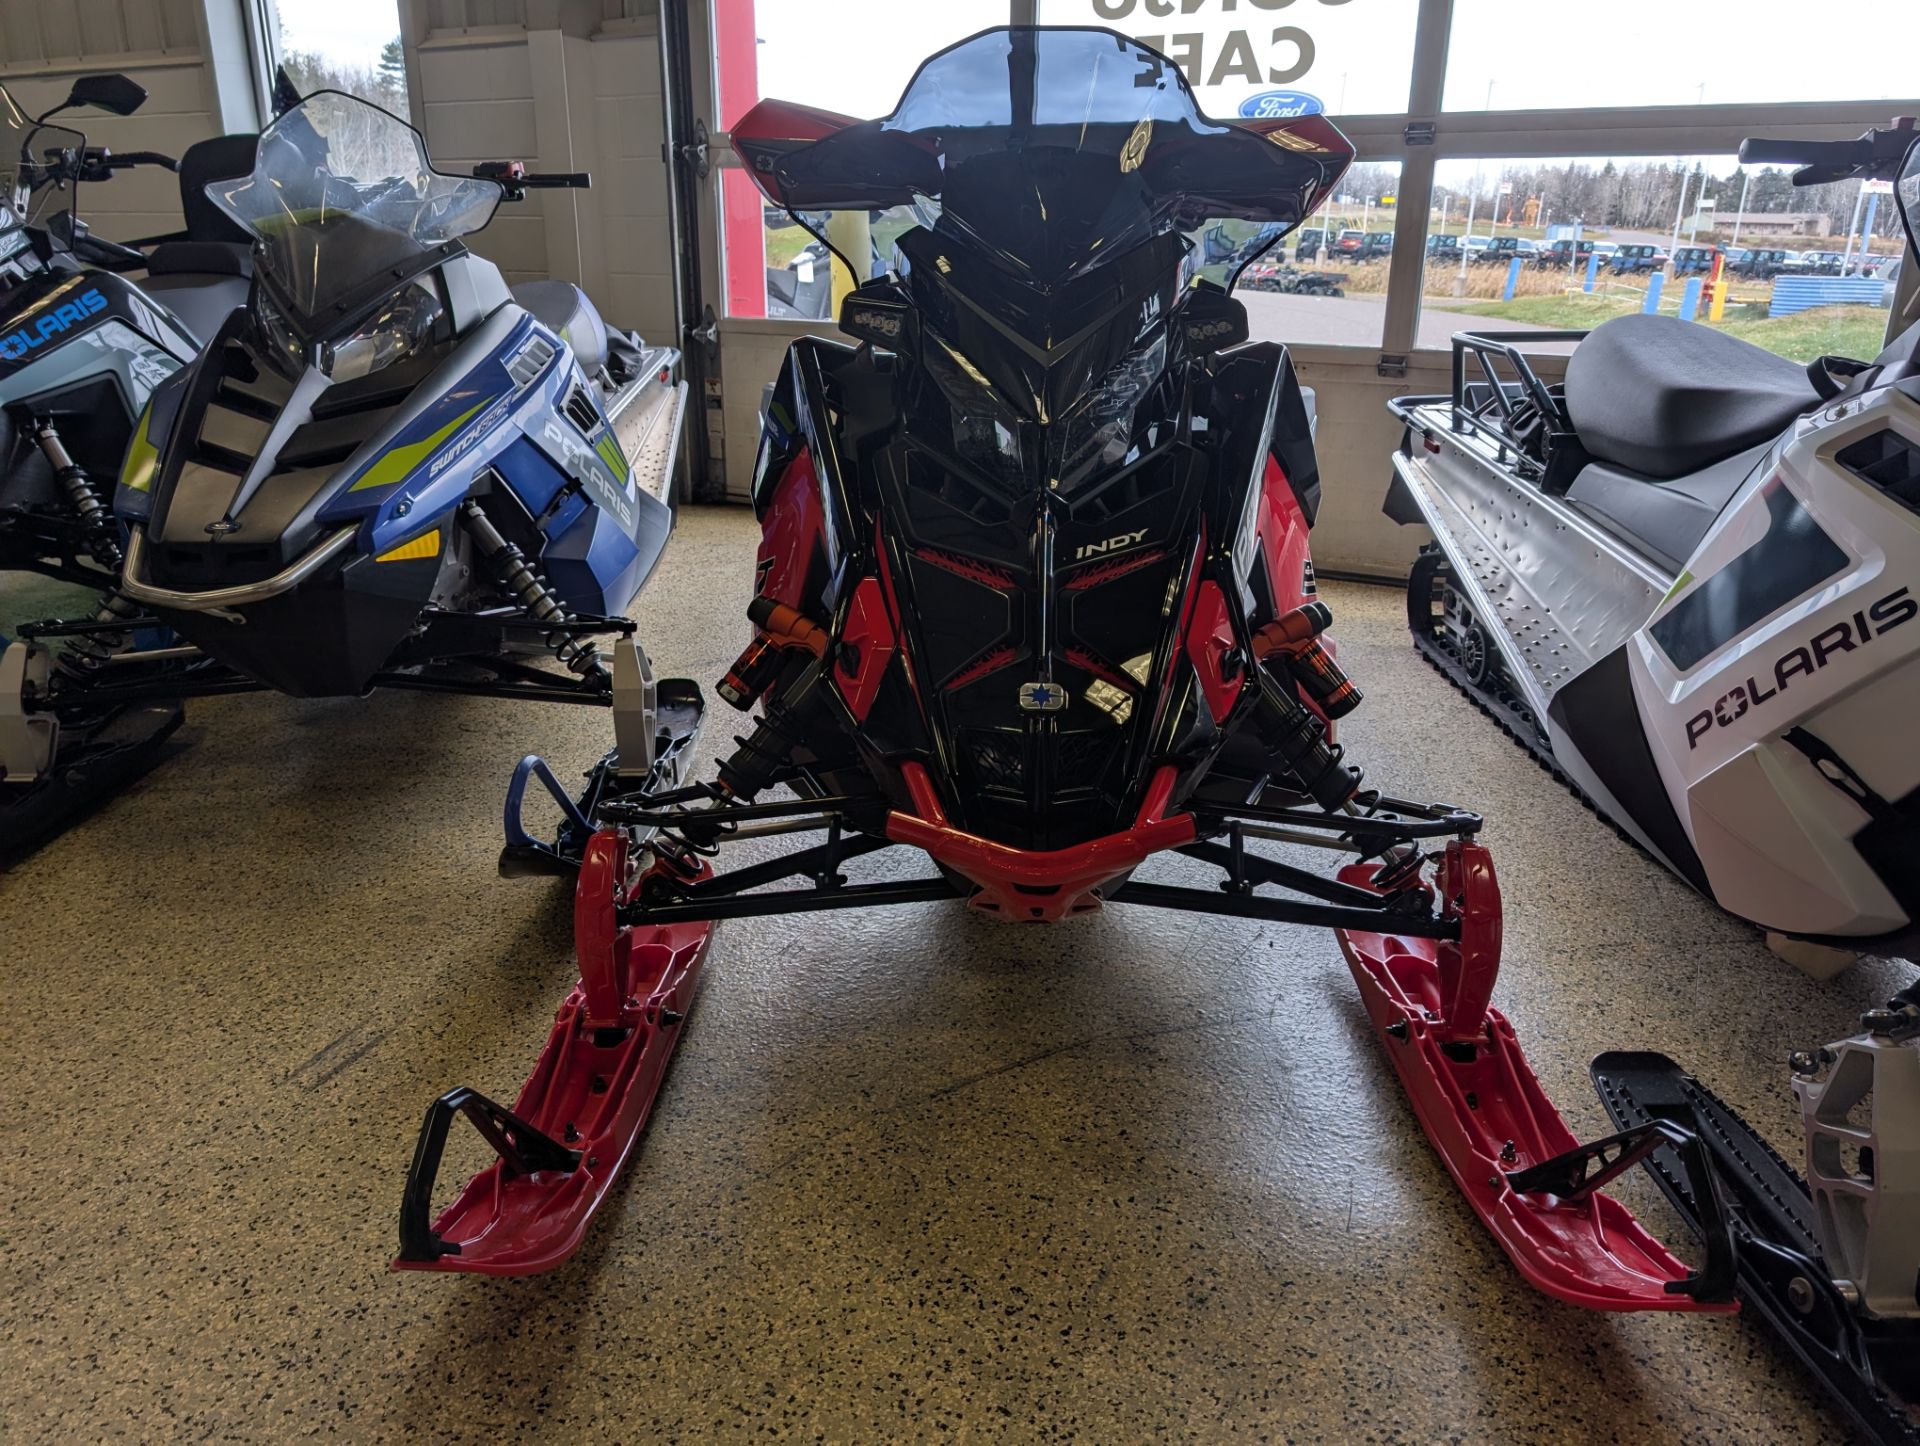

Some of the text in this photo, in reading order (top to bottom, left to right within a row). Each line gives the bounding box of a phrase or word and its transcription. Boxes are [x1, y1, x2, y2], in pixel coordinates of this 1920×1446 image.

[1256, 96, 1308, 118] Ford
[543, 420, 632, 527] POLARIS
[1075, 527, 1150, 560] INDY
[1684, 585, 1919, 751] POLARIS
